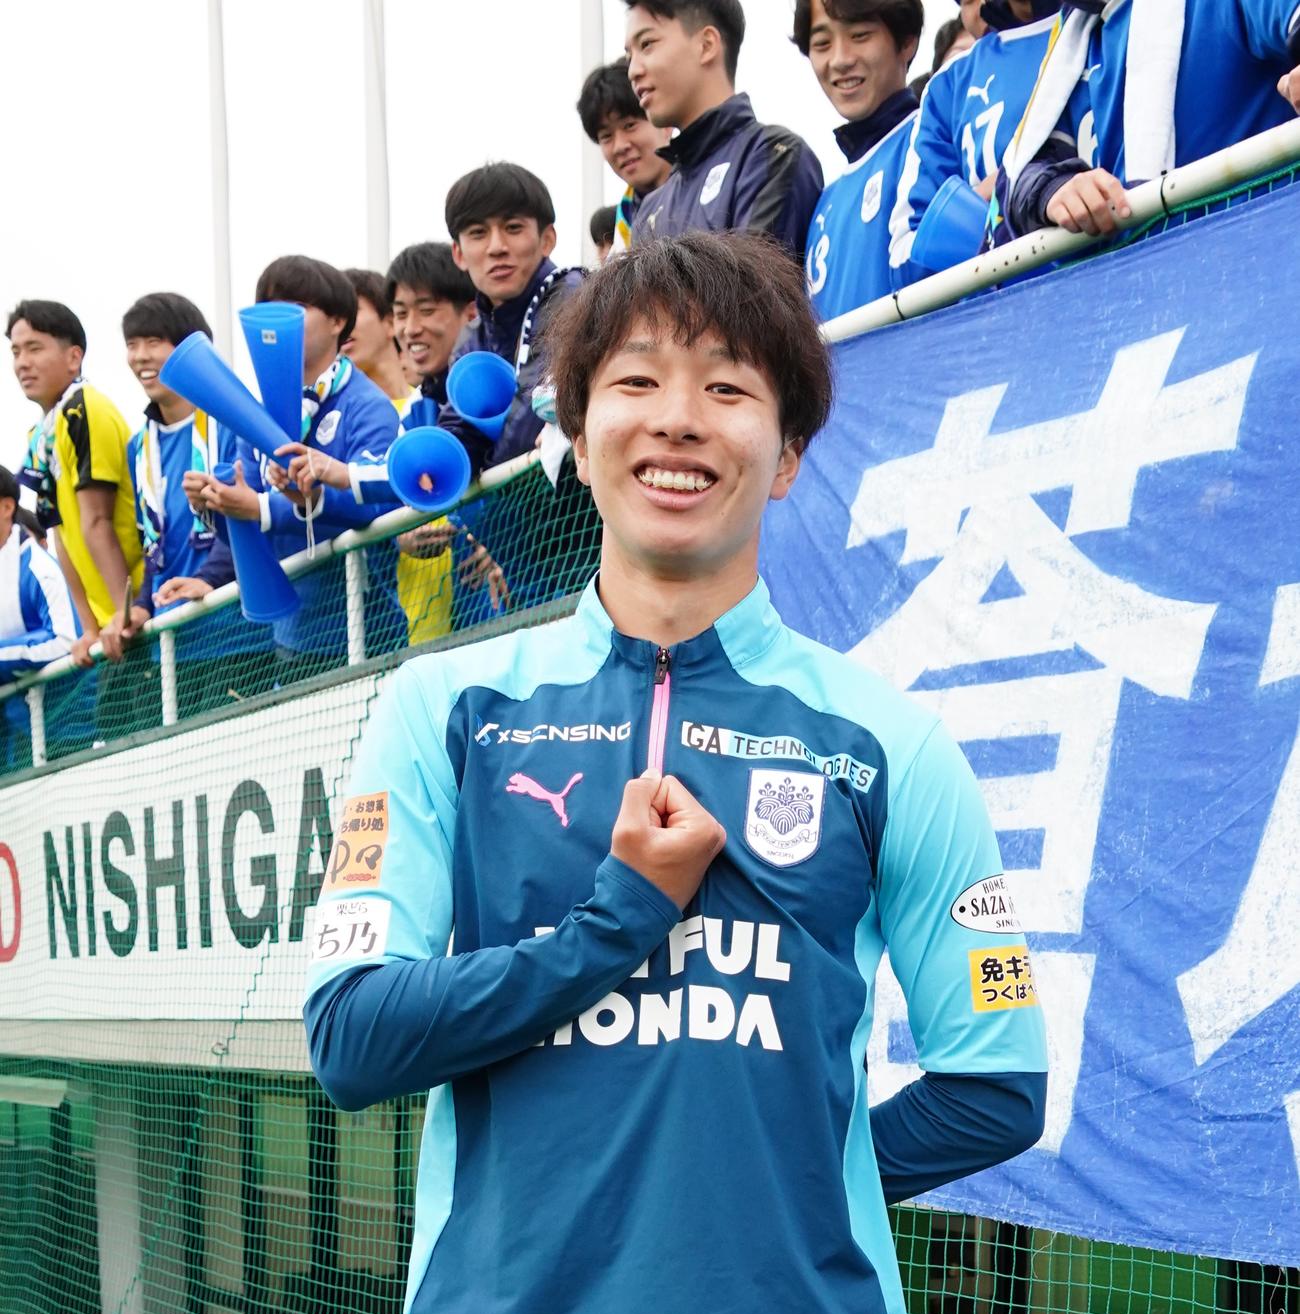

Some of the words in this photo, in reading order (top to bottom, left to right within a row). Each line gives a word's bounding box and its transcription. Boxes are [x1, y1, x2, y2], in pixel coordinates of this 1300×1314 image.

[962, 101, 1004, 188] 17
[687, 723, 722, 754] GA
[971, 896, 1006, 917] SAZA
[313, 921, 378, 960] ち乃
